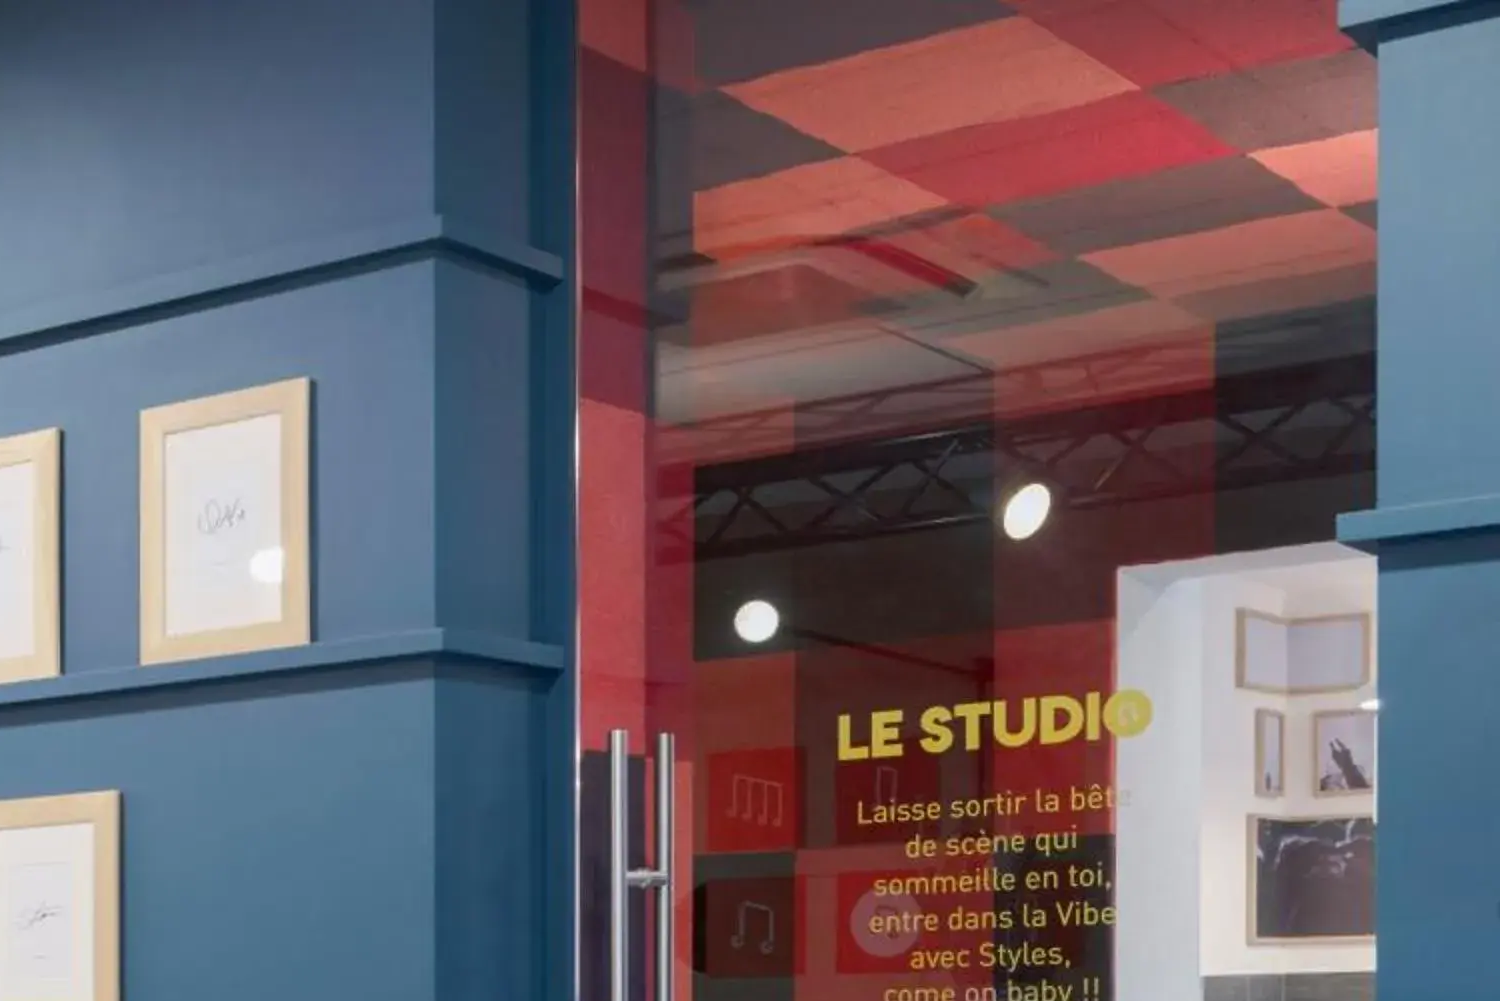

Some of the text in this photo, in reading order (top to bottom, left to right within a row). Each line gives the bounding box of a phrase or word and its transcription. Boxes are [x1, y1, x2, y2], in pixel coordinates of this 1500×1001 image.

[837, 688, 1154, 762] LE STUDIO
[857, 799, 942, 825] Laisse
[950, 791, 1031, 819] sortir
[1035, 787, 1060, 814] la
[904, 824, 1078, 861] de scène qui
[873, 865, 1113, 897] sommeille en toi,
[868, 901, 1118, 935] entre dans la Vibe
[910, 941, 1072, 974] avec Styles,
